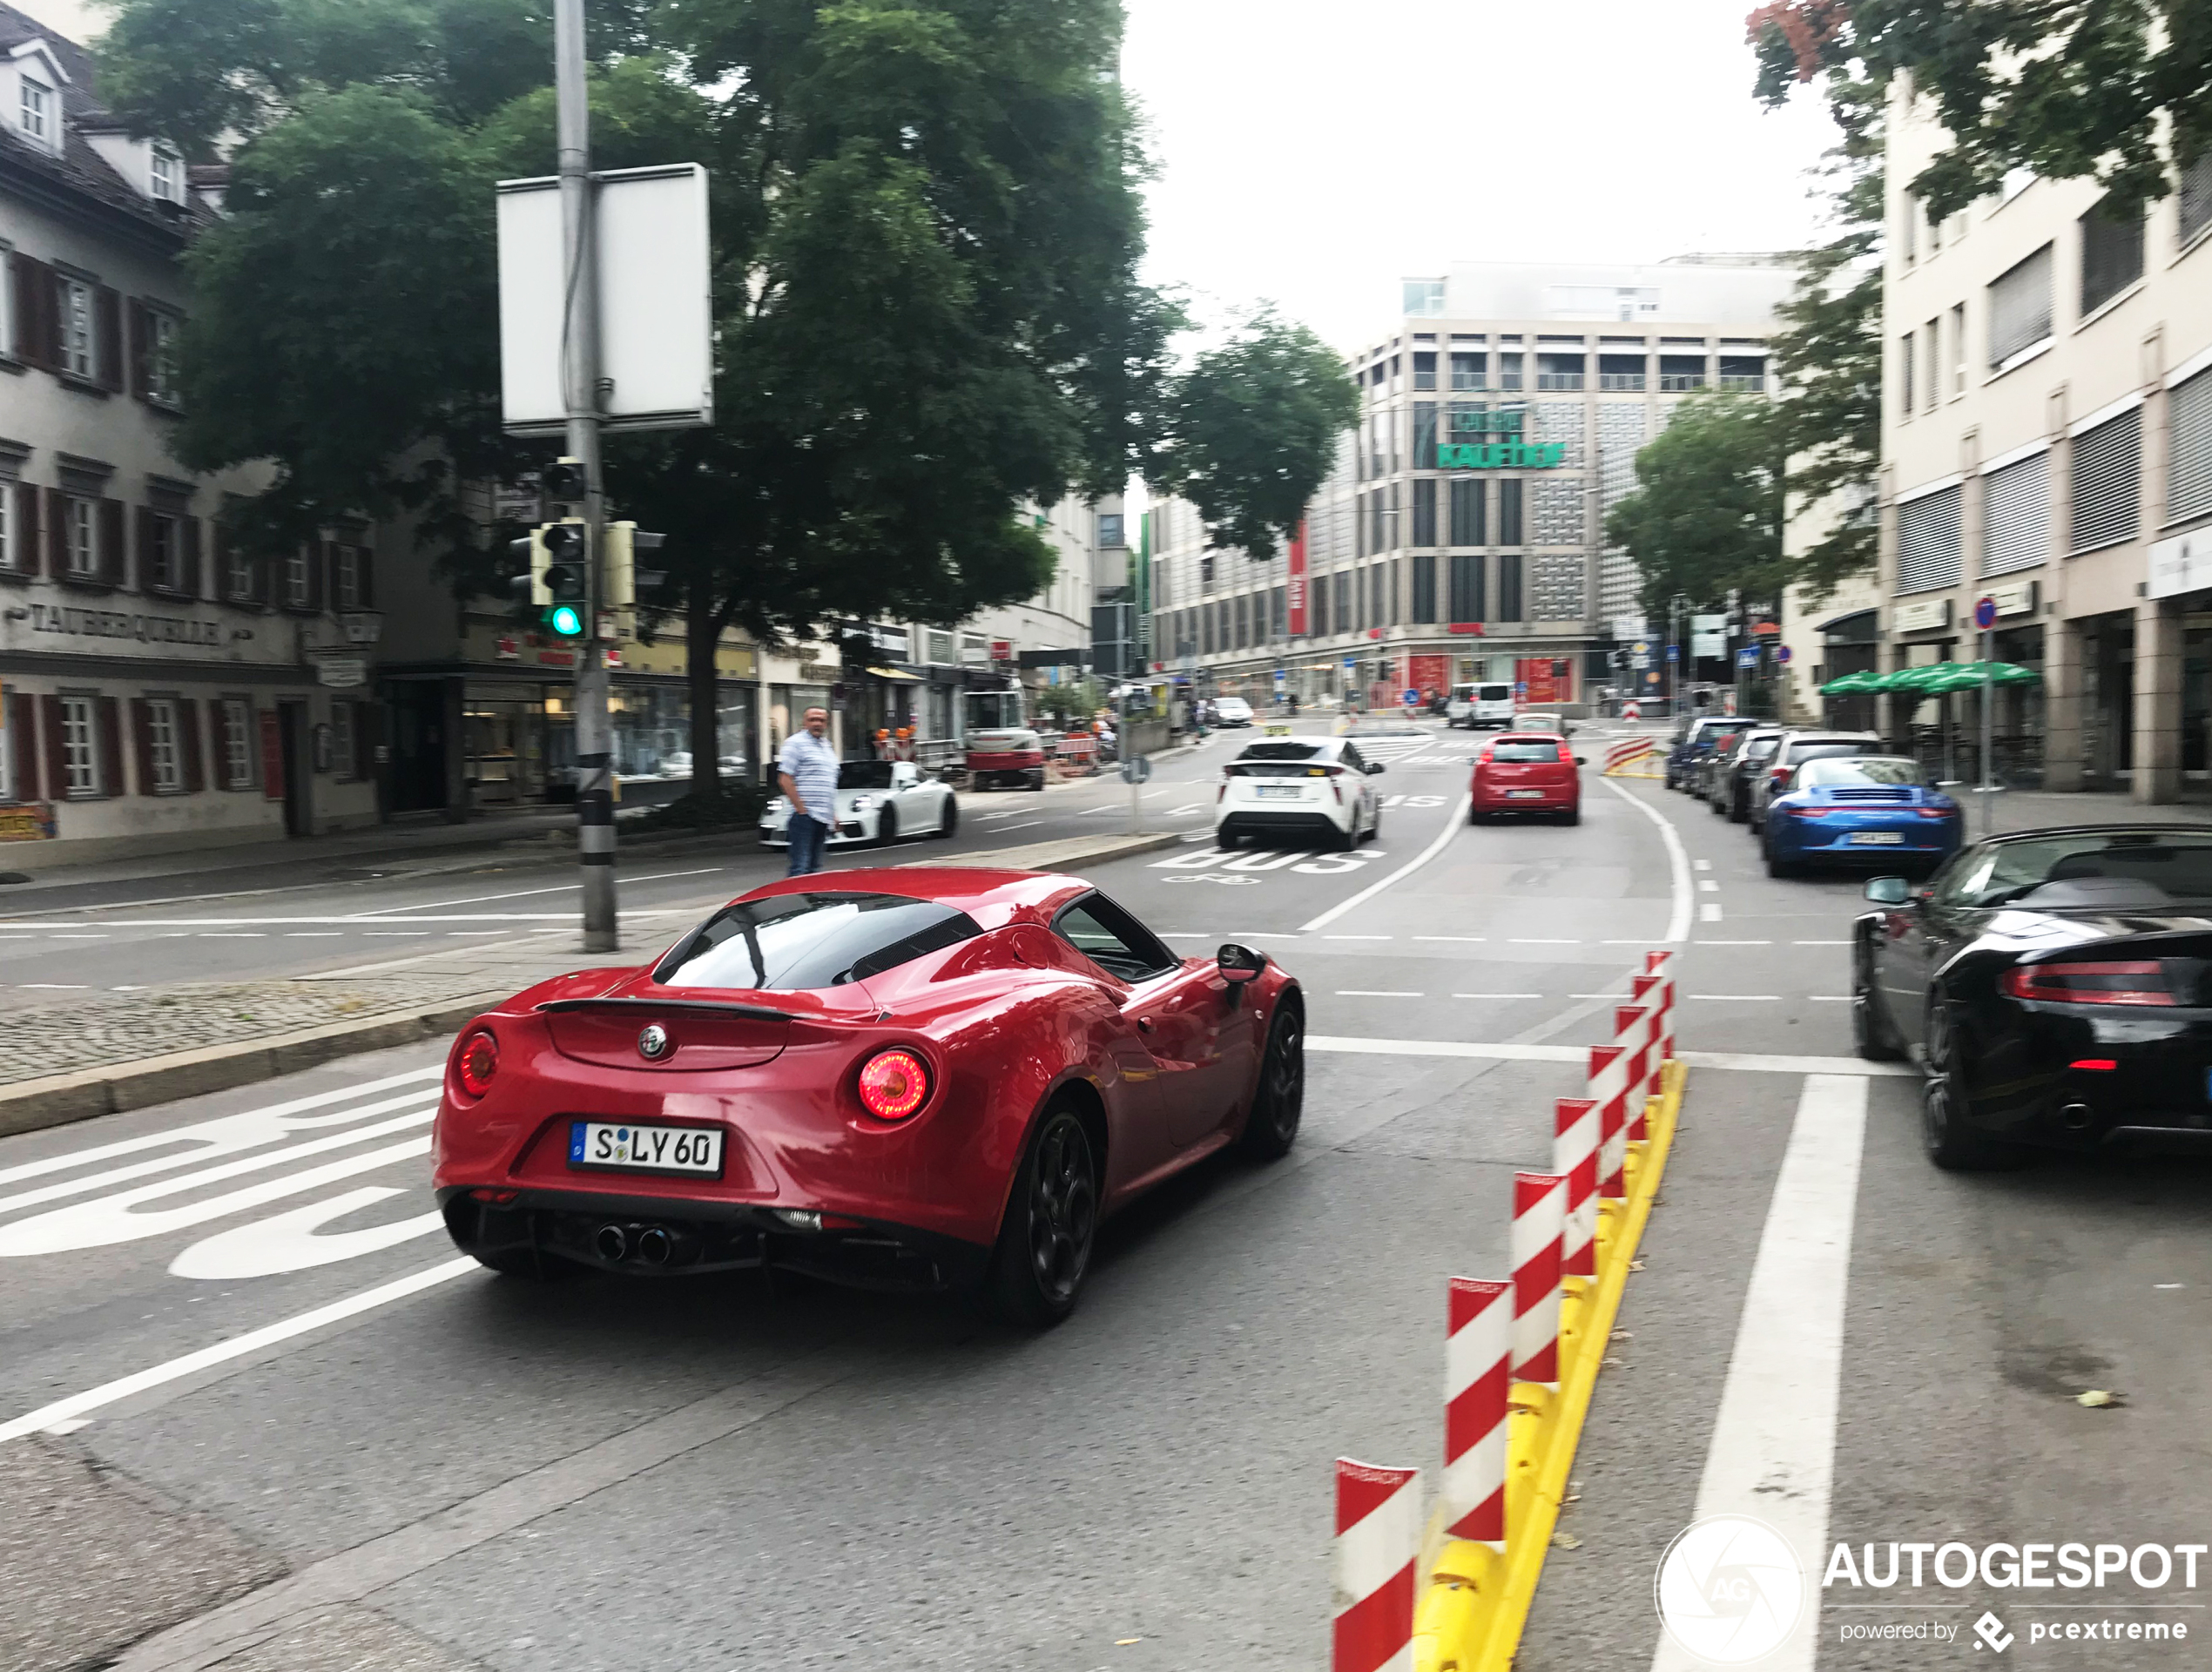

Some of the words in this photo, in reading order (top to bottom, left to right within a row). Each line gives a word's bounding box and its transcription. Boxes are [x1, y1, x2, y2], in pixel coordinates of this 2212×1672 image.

[29, 603, 219, 646] TAUBERQUELLE
[1144, 846, 1388, 874] BUS
[595, 1129, 614, 1159] S
